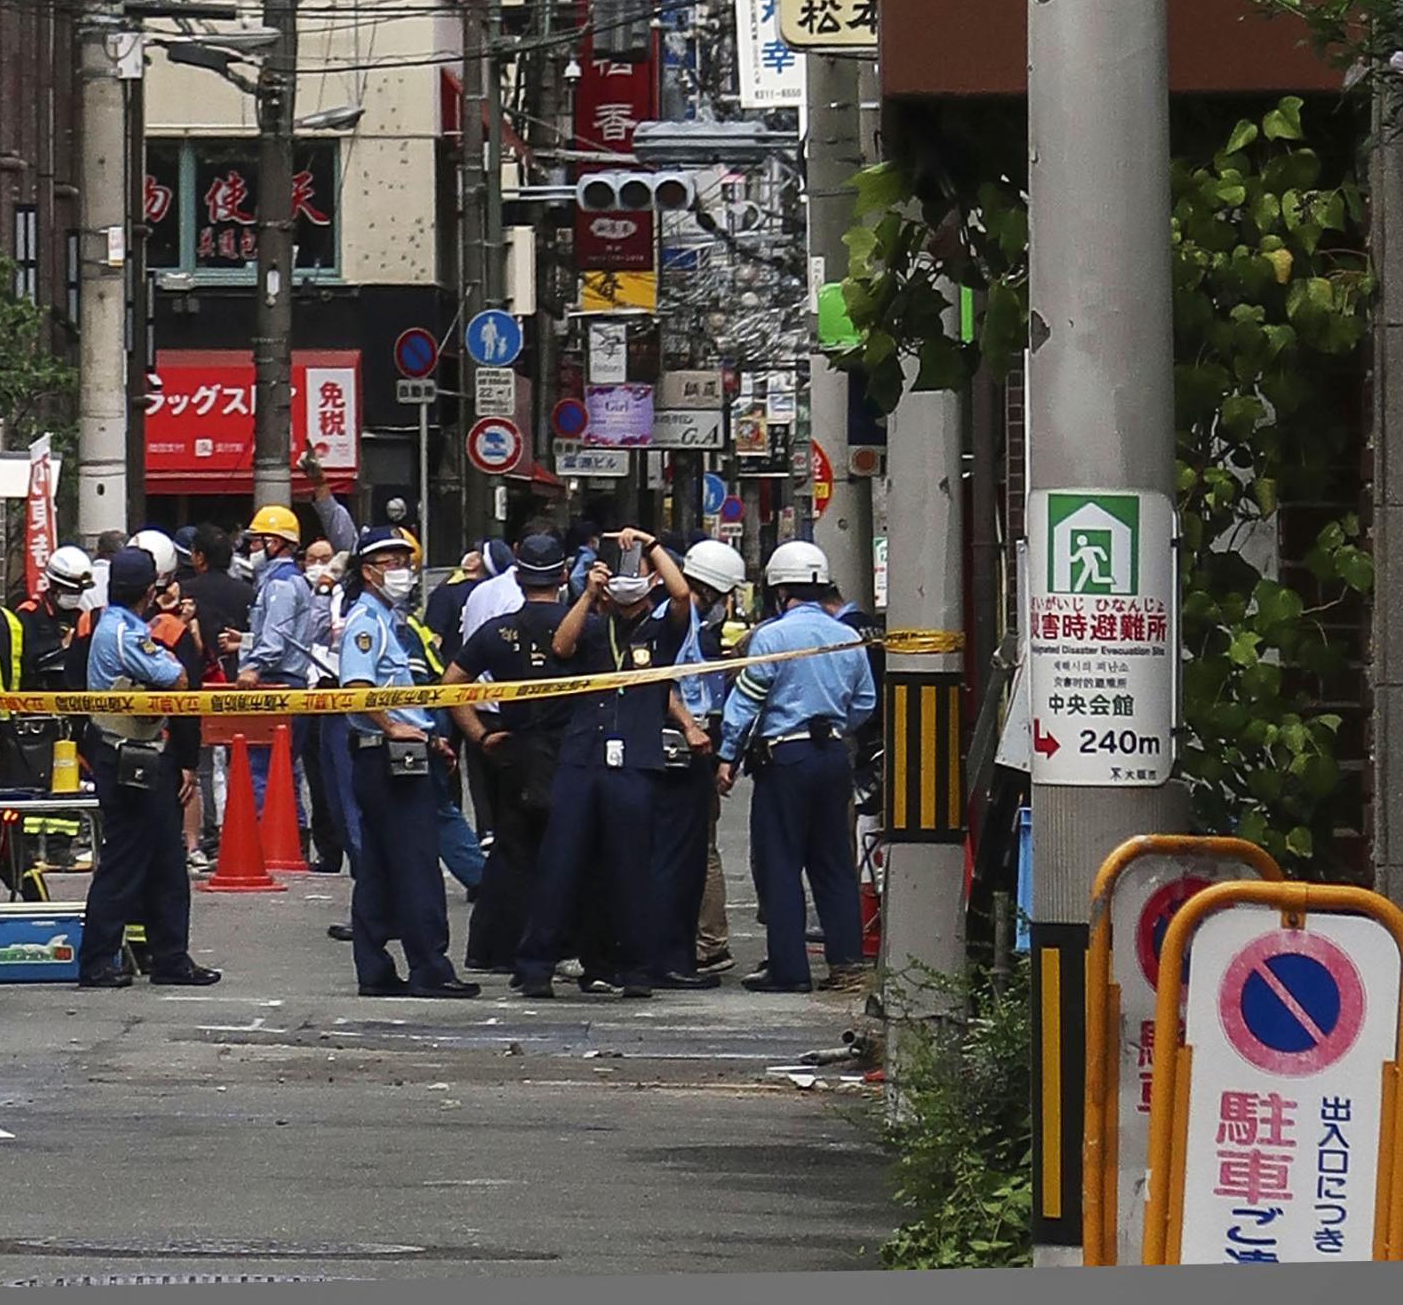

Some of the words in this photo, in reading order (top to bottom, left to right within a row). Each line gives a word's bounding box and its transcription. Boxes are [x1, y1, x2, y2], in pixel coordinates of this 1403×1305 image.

[319, 381, 346, 437] 免税
[55, 695, 134, 712] 大阪市消防局
[147, 694, 200, 711] 立入禁止
[211, 694, 290, 712] 大阪市消防局
[301, 692, 357, 710] 立入禁止
[1049, 694, 1135, 717] 中央会館
[1079, 730, 1161, 755] 240m
[1313, 1095, 1351, 1254] 出入口につき
